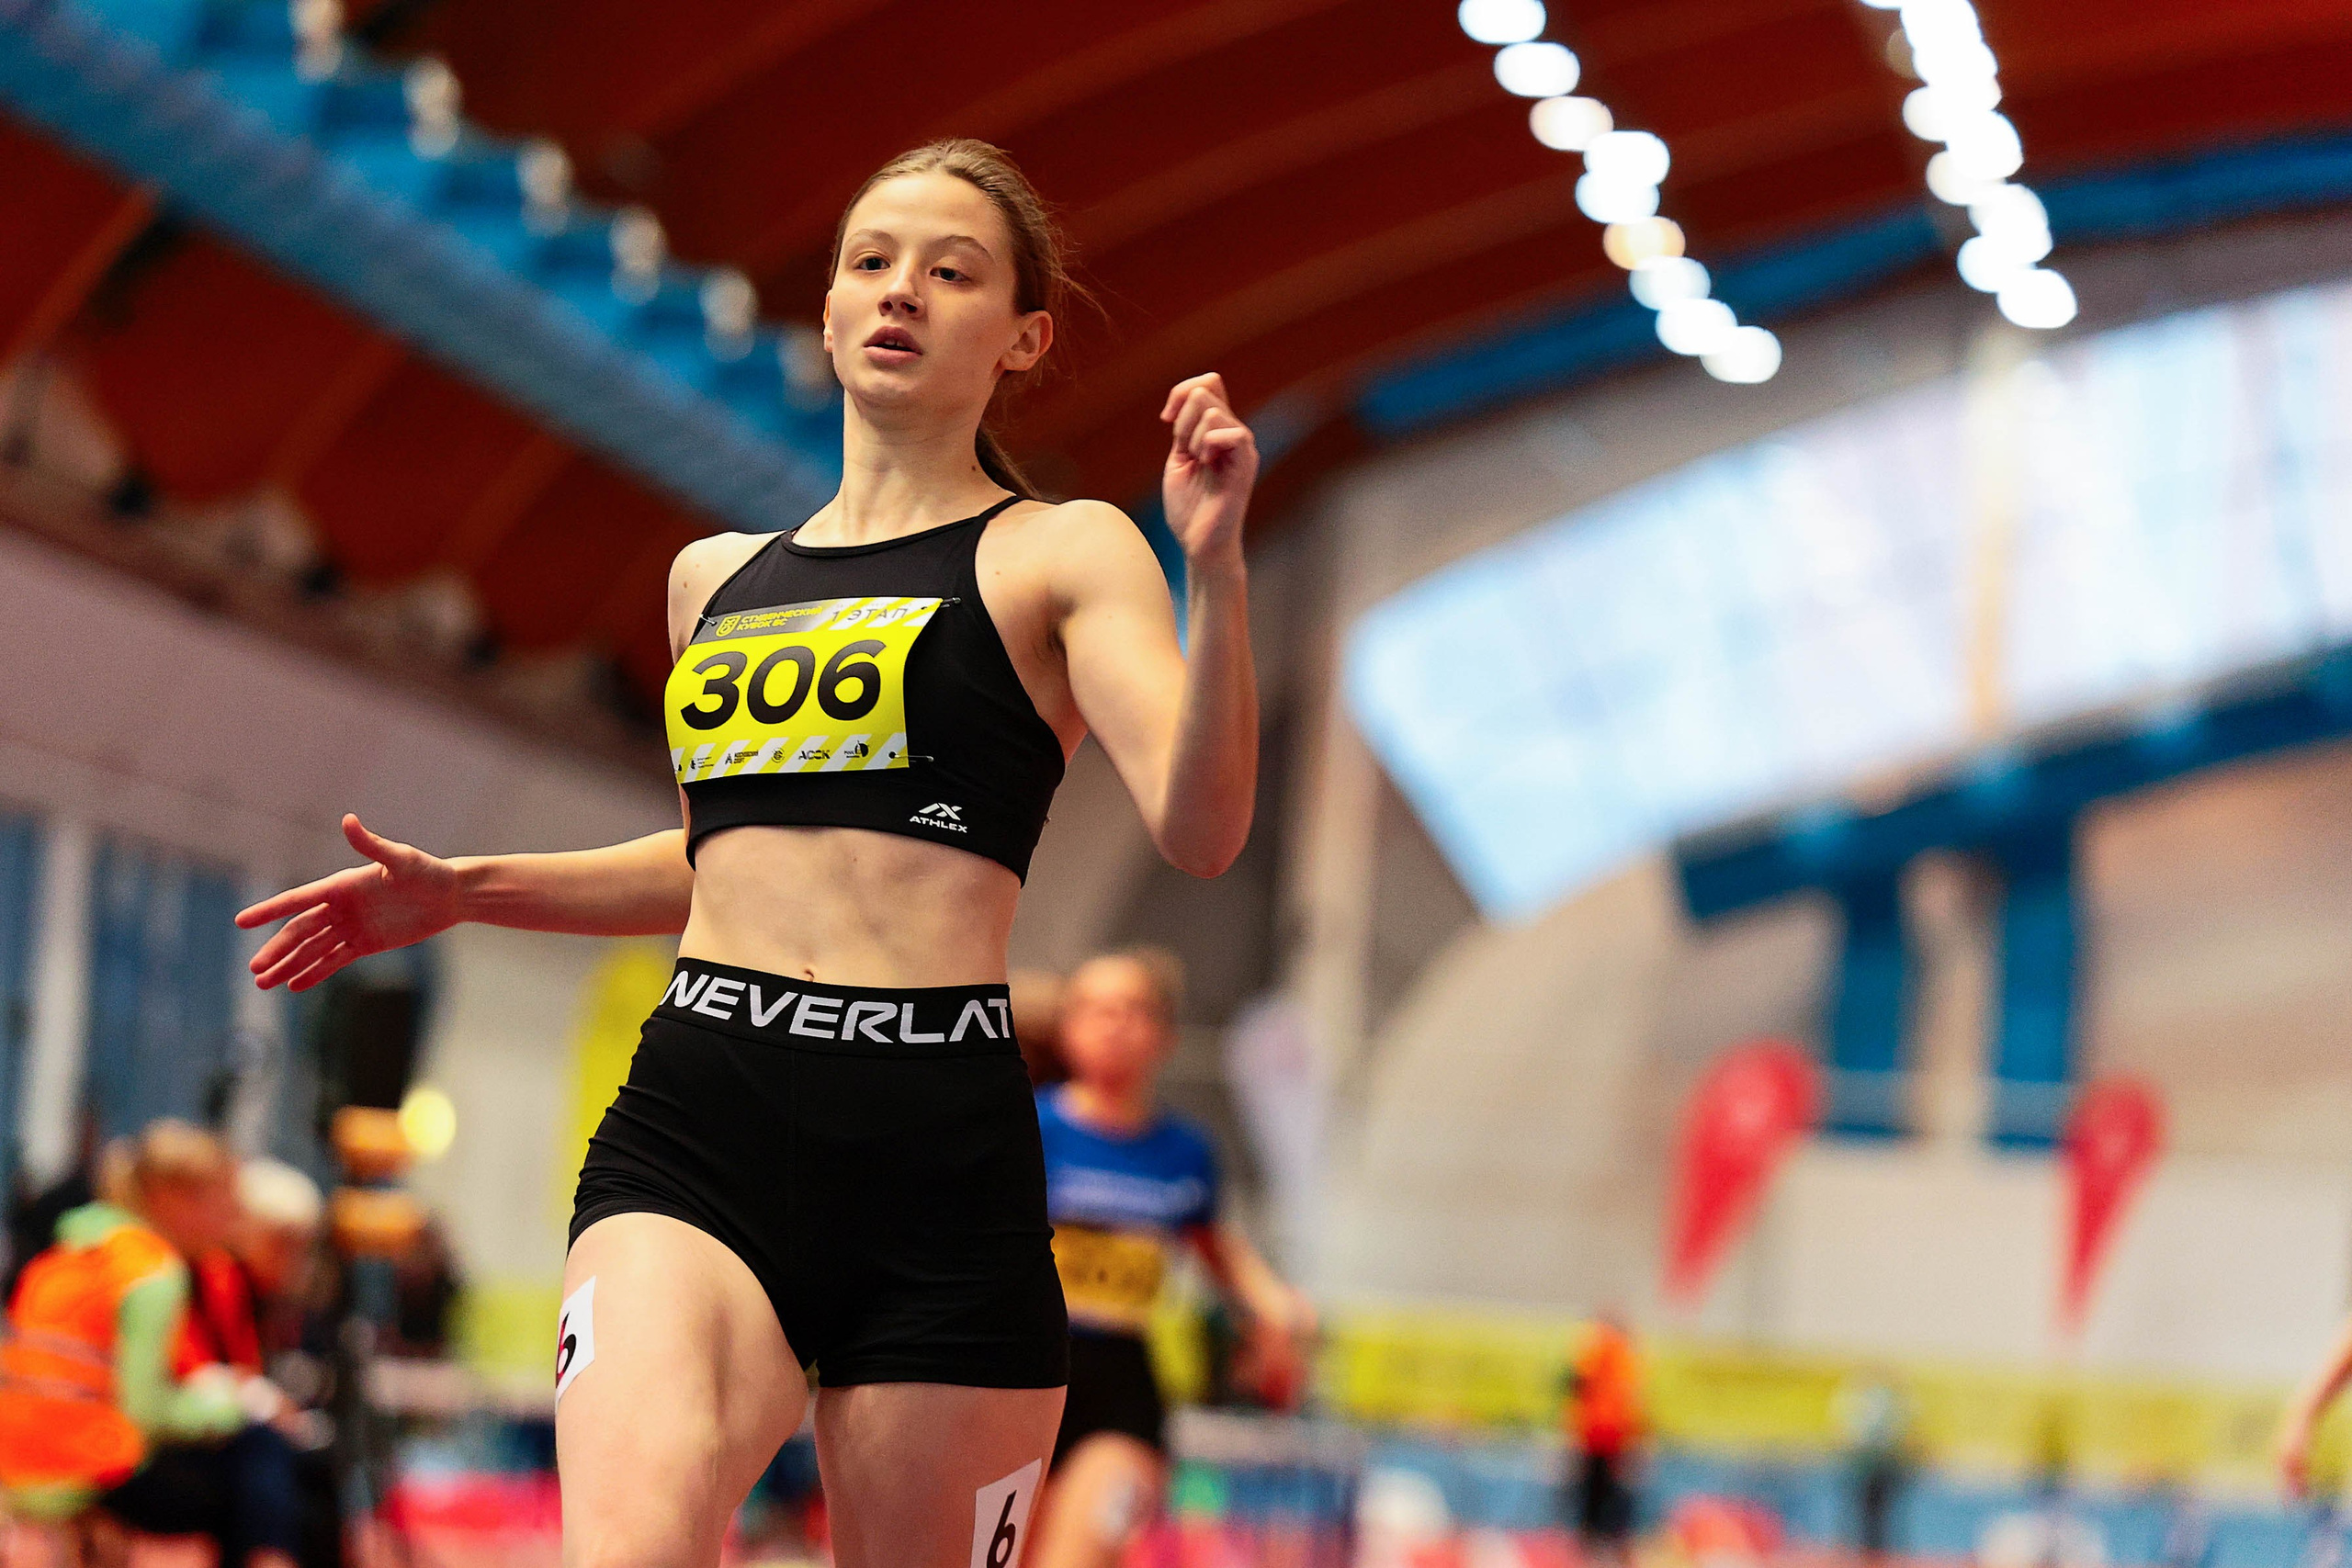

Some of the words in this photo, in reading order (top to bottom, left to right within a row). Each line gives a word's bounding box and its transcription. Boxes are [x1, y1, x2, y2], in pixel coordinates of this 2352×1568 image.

[832, 610, 842, 622] 1
[847, 608, 909, 620] ЭТАП
[681, 639, 887, 730] 306
[909, 816, 967, 833] ATHLEX
[556, 1311, 577, 1389] 6
[986, 1489, 1017, 1568] 6
